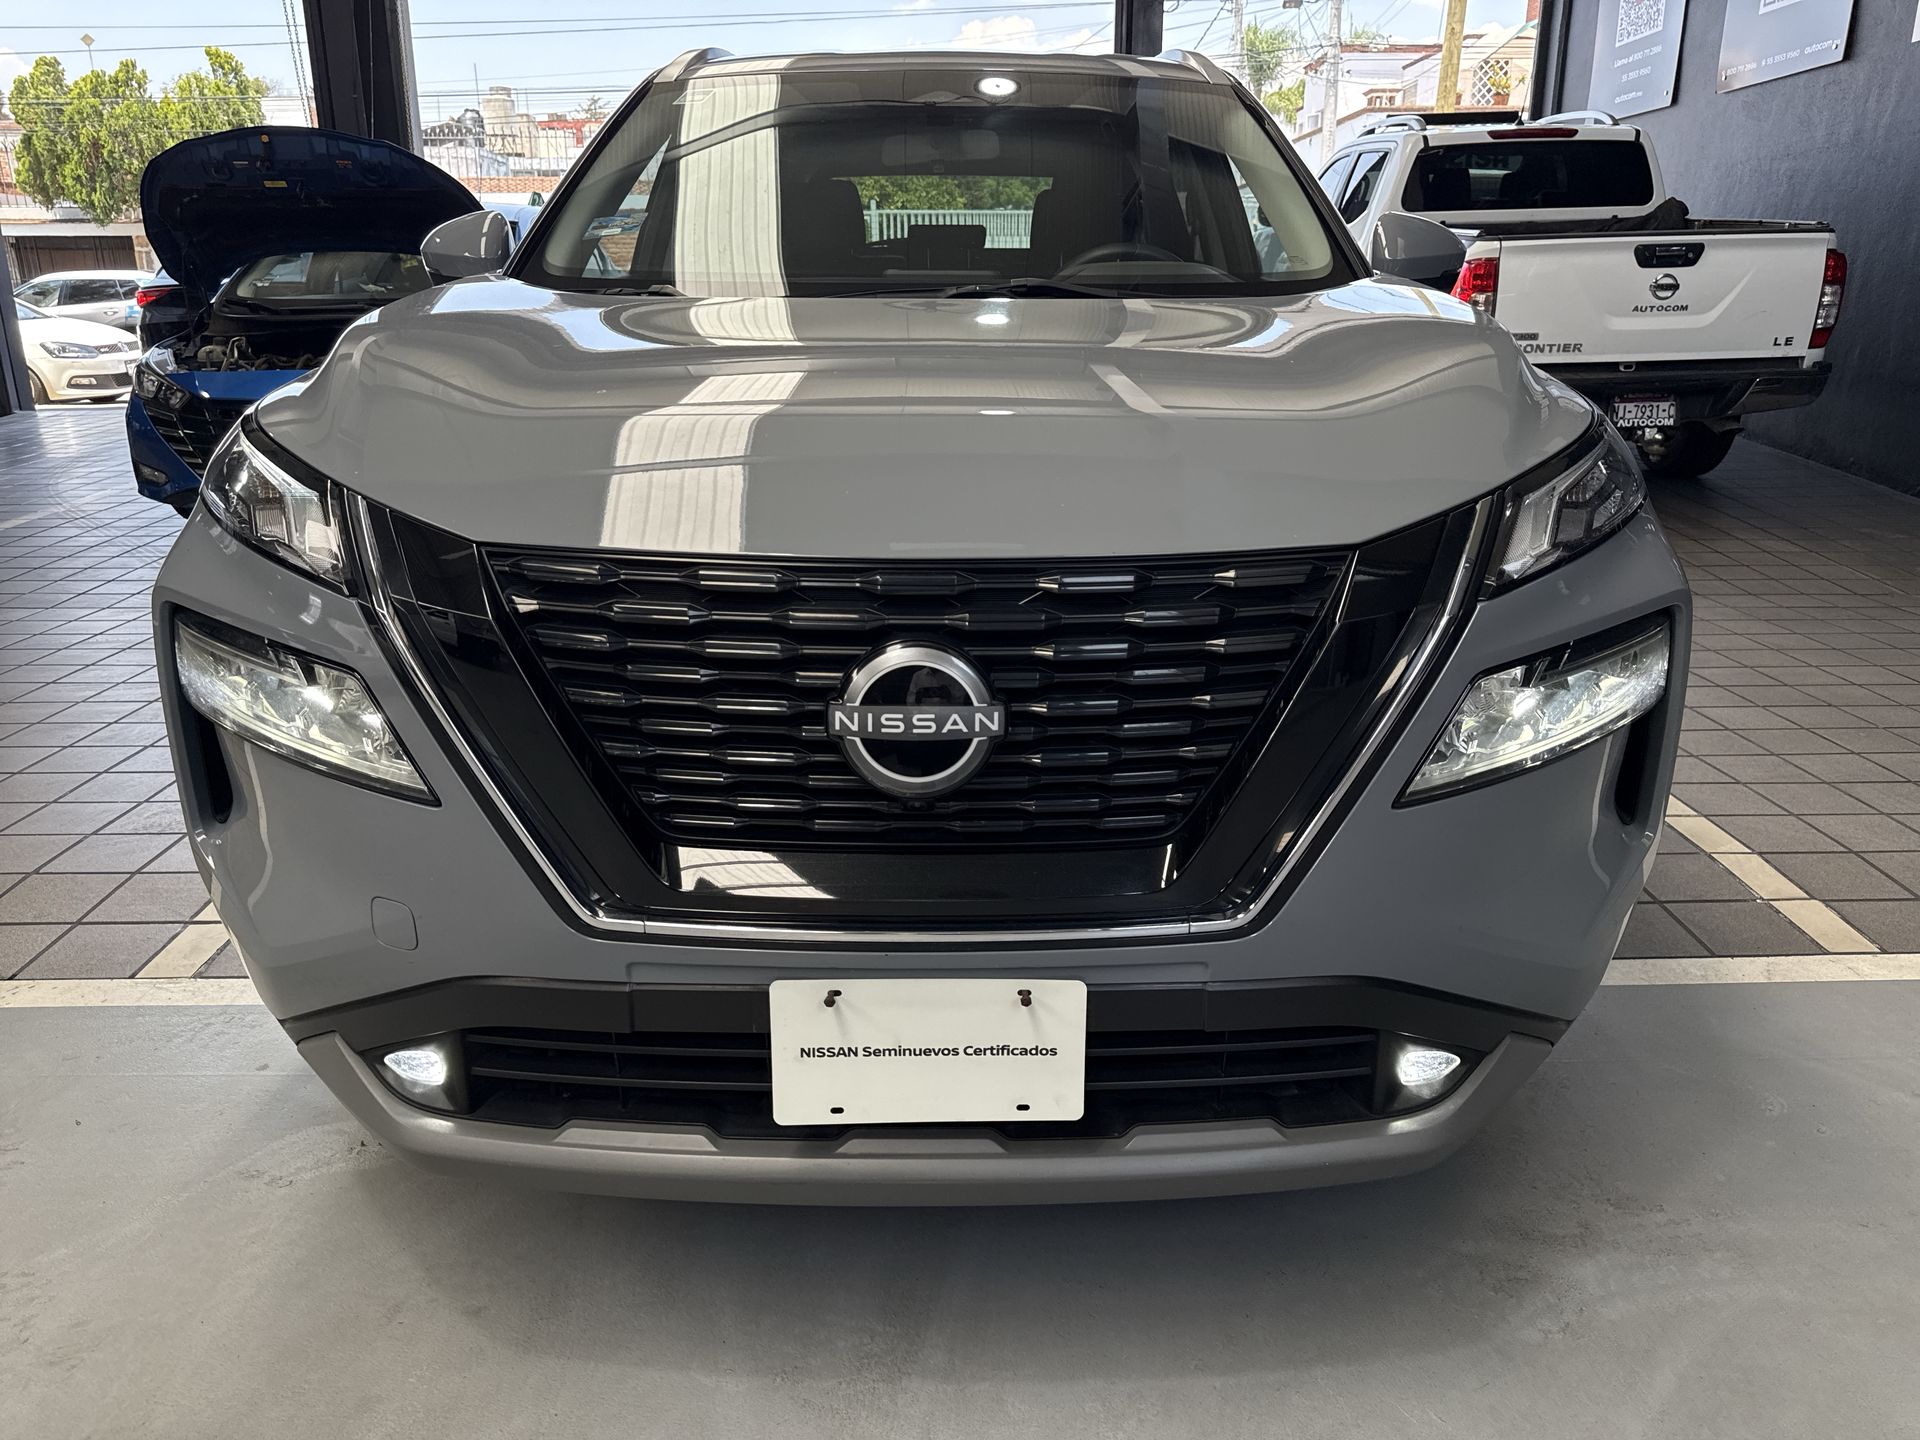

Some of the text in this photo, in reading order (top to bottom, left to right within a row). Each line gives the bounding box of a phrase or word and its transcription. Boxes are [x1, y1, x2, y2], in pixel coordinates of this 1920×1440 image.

[1632, 304, 1689, 313] AUTOCOM
[1772, 336, 1794, 347] LE
[1519, 343, 1583, 354] ONTIER
[1617, 418, 1674, 427] AUTOCOM
[835, 711, 999, 734] NISSAN
[800, 1044, 1058, 1058] NISSAN Seminuevos Certificados
